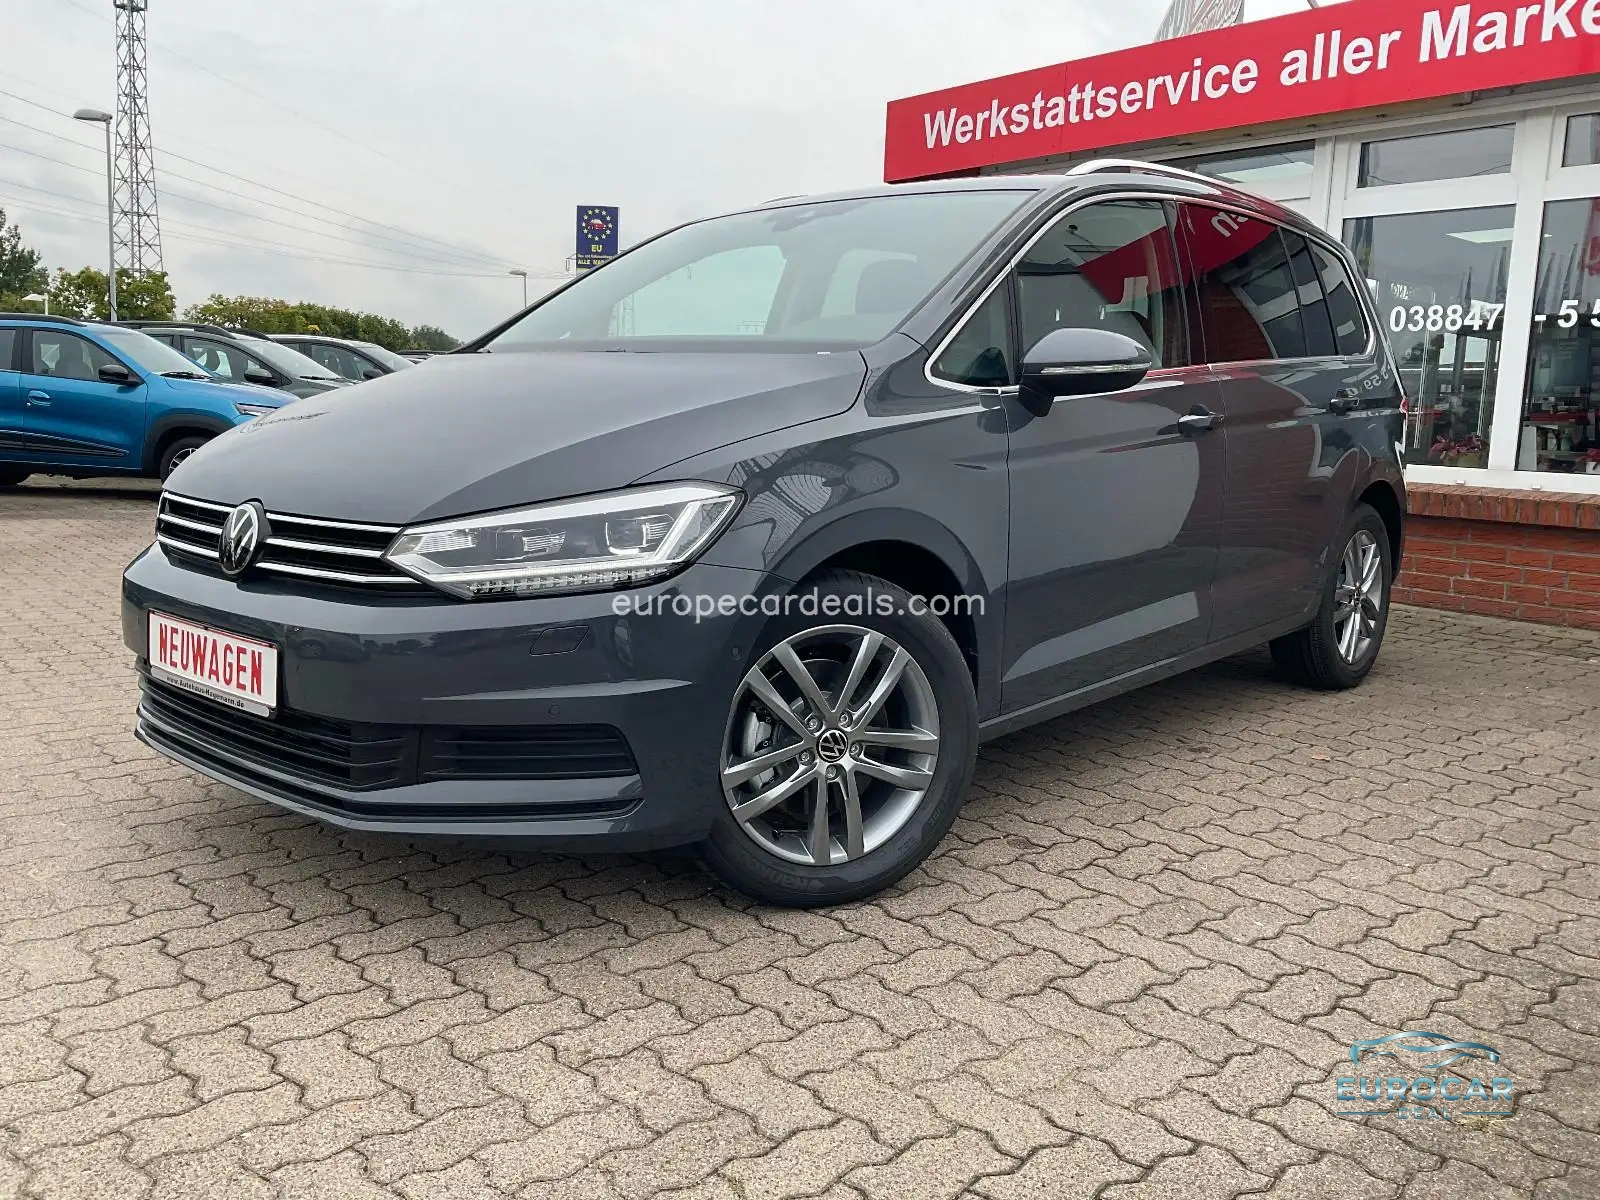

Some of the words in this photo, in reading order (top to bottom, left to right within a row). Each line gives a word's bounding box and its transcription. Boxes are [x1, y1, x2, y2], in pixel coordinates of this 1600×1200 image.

[923, 57, 1259, 149] Werkstattservice
[1279, 29, 1402, 86] aller
[591, 244, 603, 252] EU
[1389, 303, 1505, 333] 038847
[158, 621, 263, 696] NEUWAGEN
